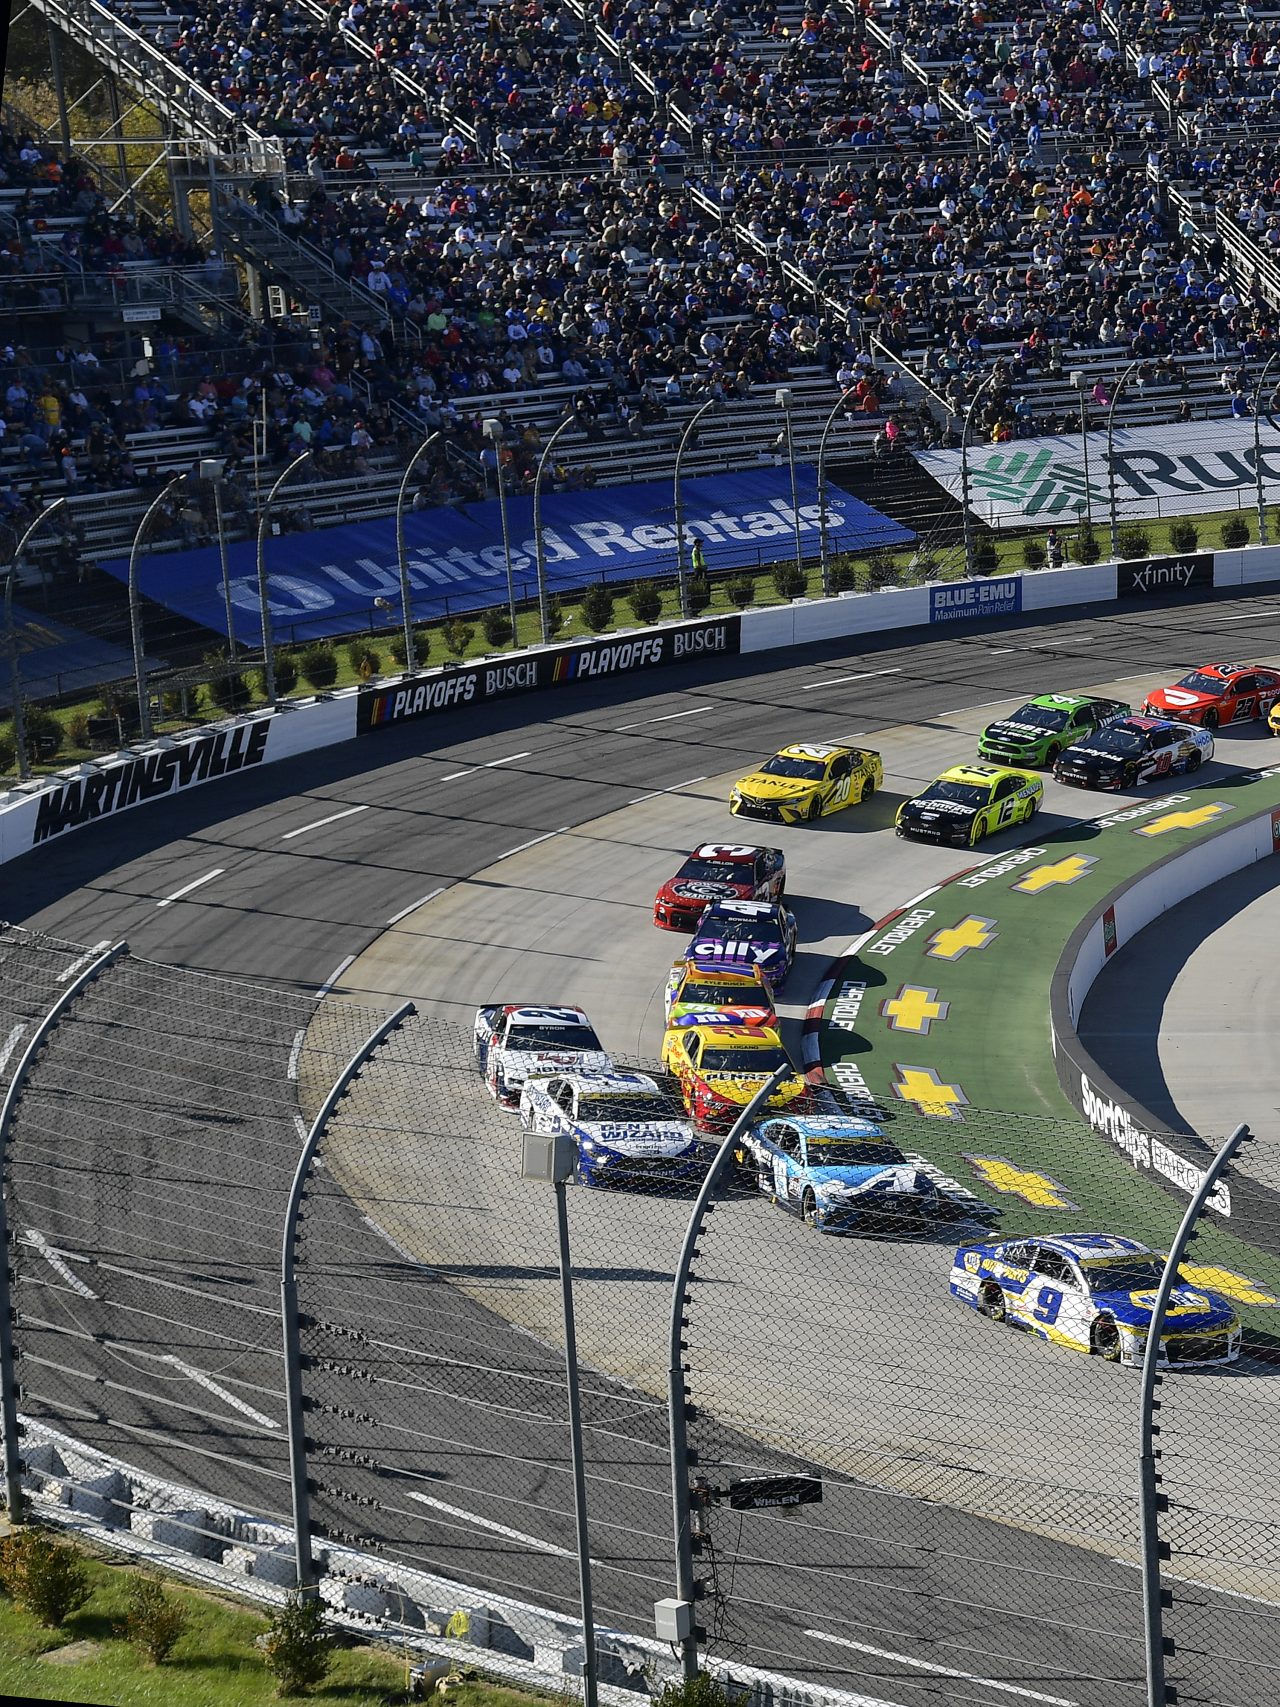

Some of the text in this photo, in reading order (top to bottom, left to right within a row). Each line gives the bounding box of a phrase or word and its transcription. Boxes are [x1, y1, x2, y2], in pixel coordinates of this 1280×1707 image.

[321, 526, 580, 597] United
[1132, 562, 1195, 591] xfinity
[934, 582, 1016, 608] BLUE-EMU
[576, 625, 726, 678] PLAYOFFS BUSCH
[393, 661, 538, 719] PLAYOFFS BUSCH
[1233, 696, 1256, 721] 23
[994, 720, 1058, 737] UNIBET
[1066, 746, 1125, 762] Smithfield
[1152, 751, 1173, 776] 10
[33, 719, 271, 845] MARTINSVILLE
[738, 776, 812, 793] STANLEY
[853, 762, 878, 782] STANLEY
[834, 776, 851, 805] 20
[1016, 782, 1042, 799] MENARDS
[997, 797, 1015, 826] 12
[1085, 794, 1192, 830] CHEVROLET
[910, 827, 941, 836] MUSTANG
[699, 844, 756, 858] 3
[957, 847, 1048, 889] CHEVROLET
[866, 909, 936, 956] CHEVROLET
[694, 941, 779, 964] ally
[828, 980, 867, 1032] CHEVROLET
[527, 1066, 601, 1074] LIBERTY
[601, 1123, 651, 1132] DENT
[1080, 1072, 1151, 1169] SportClips
[600, 1131, 685, 1141] WIZARD
[1033, 1286, 1064, 1325] 9
[753, 1494, 801, 1508] WHELEN
